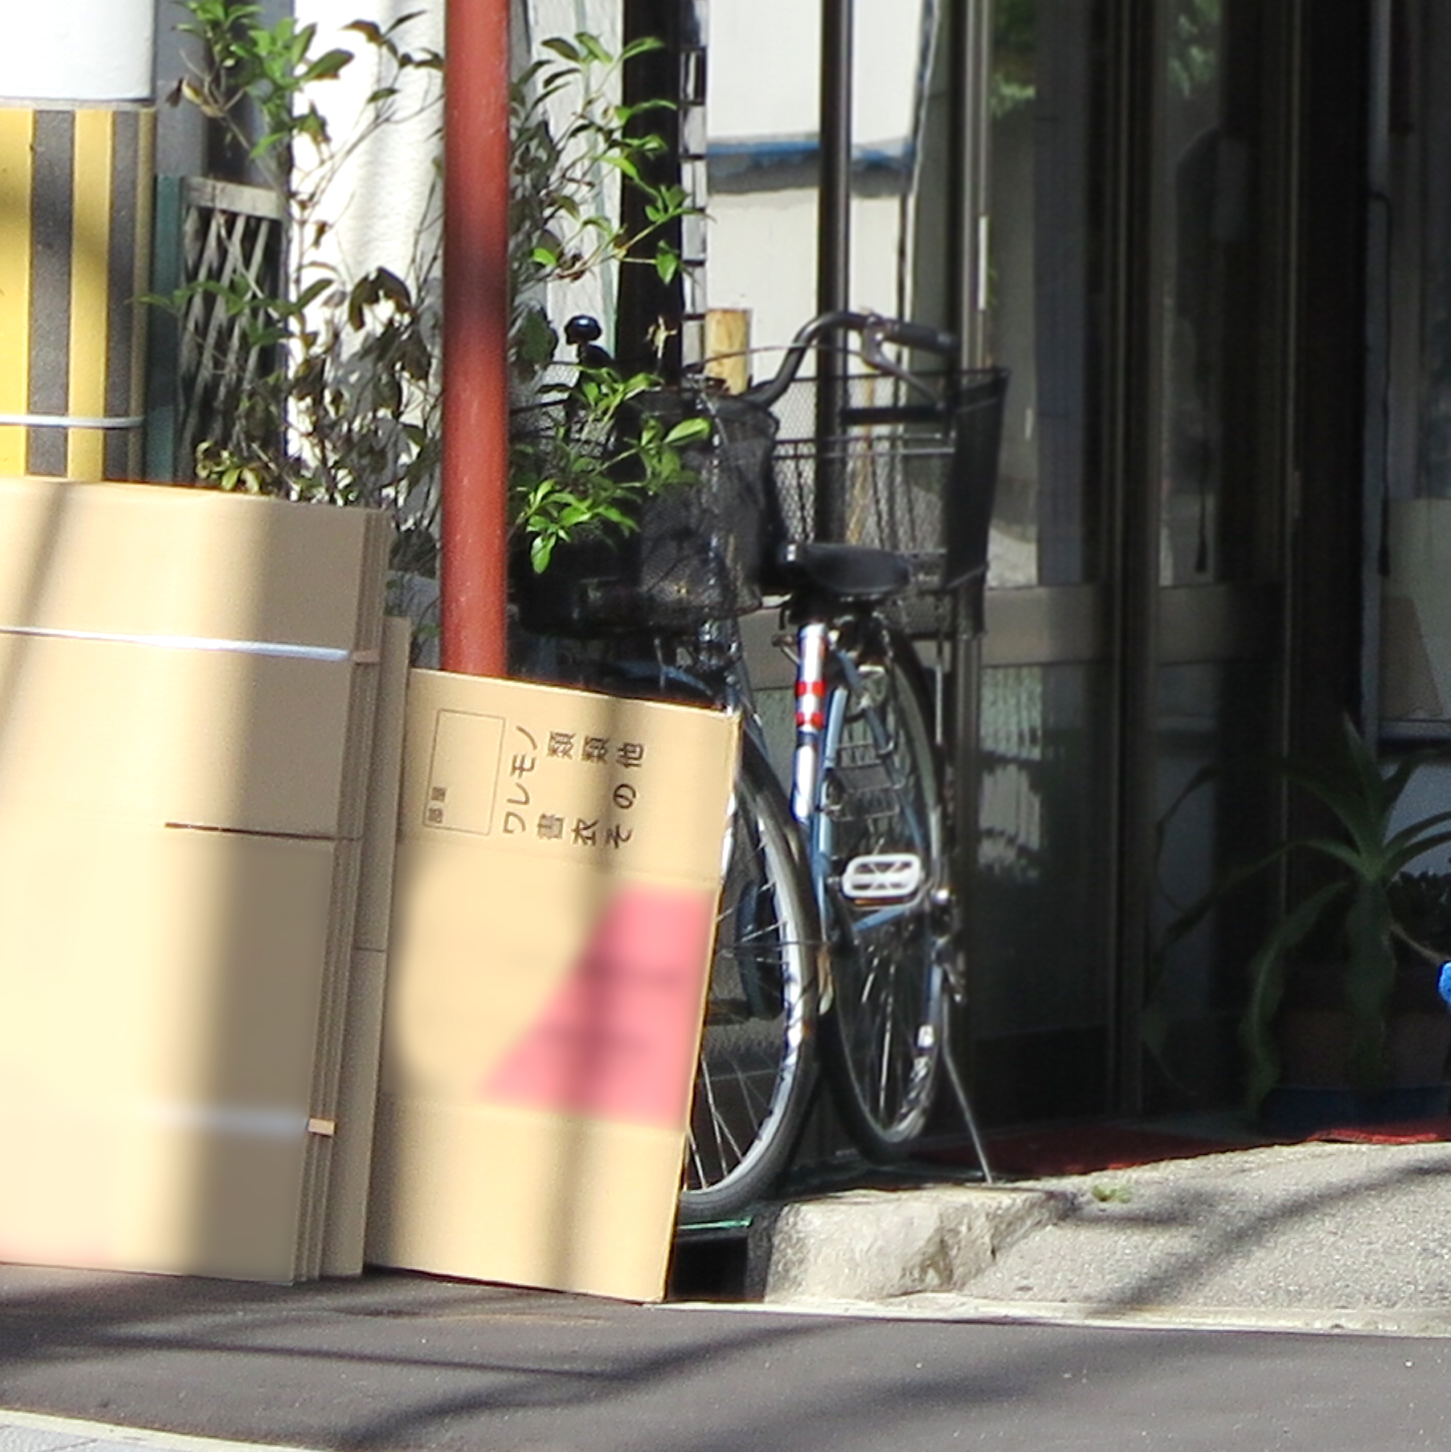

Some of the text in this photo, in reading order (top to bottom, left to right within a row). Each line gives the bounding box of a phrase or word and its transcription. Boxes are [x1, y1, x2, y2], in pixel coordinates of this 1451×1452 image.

[503, 725, 538, 835] ワレモノ
[605, 742, 644, 849] その他
